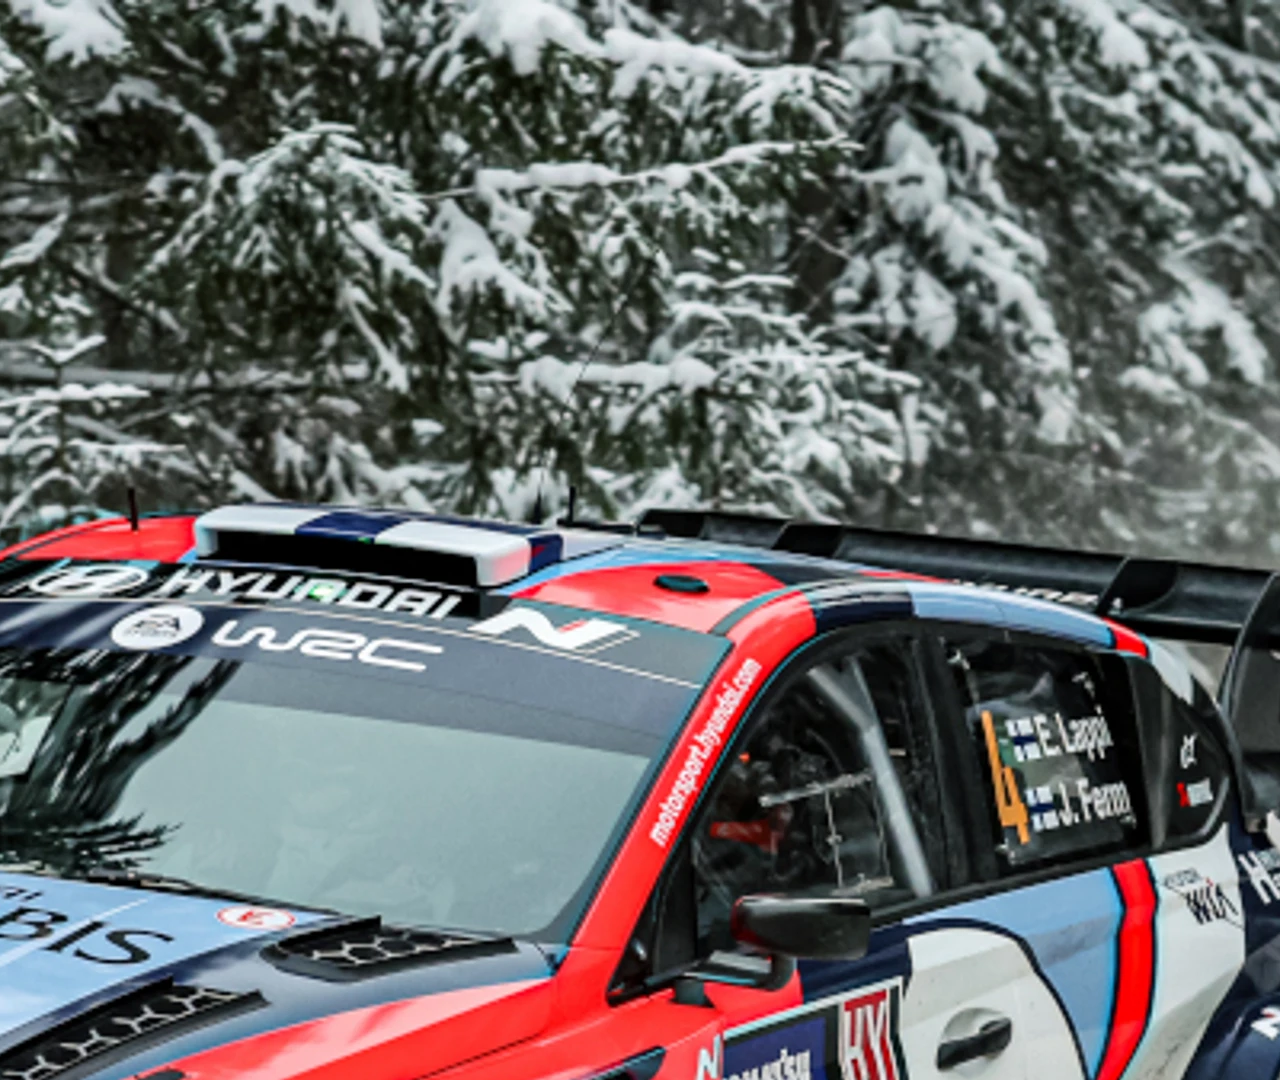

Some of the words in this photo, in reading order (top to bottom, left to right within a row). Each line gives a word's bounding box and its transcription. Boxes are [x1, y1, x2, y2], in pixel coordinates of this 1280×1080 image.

[157, 567, 463, 620] HYUNDAI
[212, 619, 443, 672] WRC
[650, 658, 763, 848] motorsport.hyundai.com
[1055, 712, 1114, 762] Lappi
[980, 710, 1031, 845] 4
